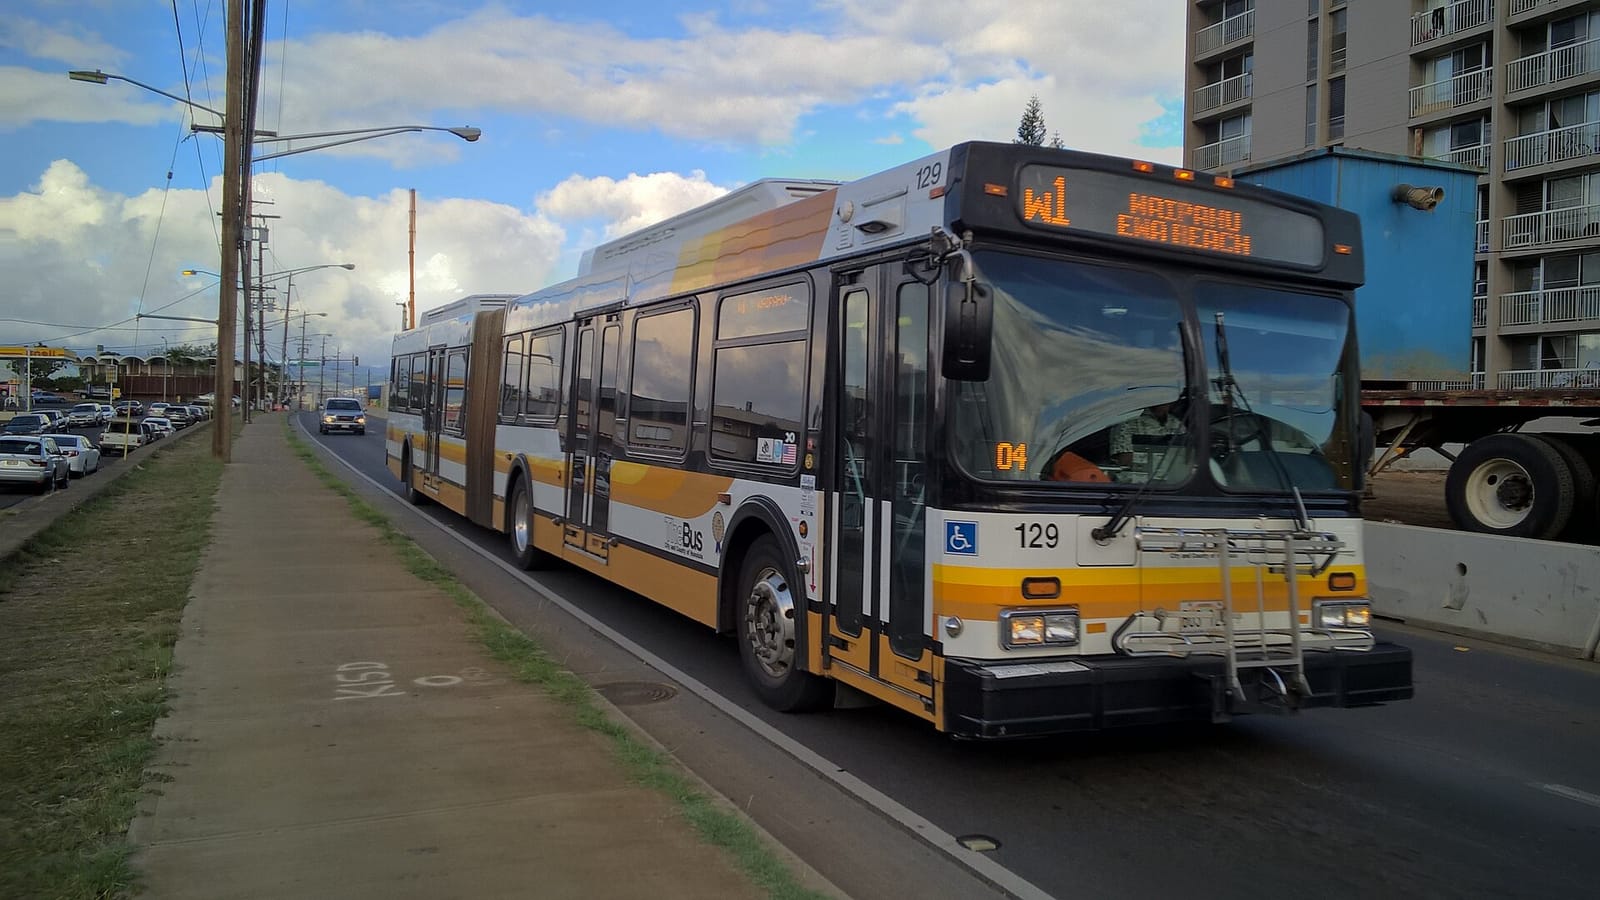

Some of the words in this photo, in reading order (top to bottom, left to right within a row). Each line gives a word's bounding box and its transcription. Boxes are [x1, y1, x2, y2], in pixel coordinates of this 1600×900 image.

[916, 162, 942, 190] 129
[996, 442, 1028, 470] 04
[1014, 522, 1059, 548] 129
